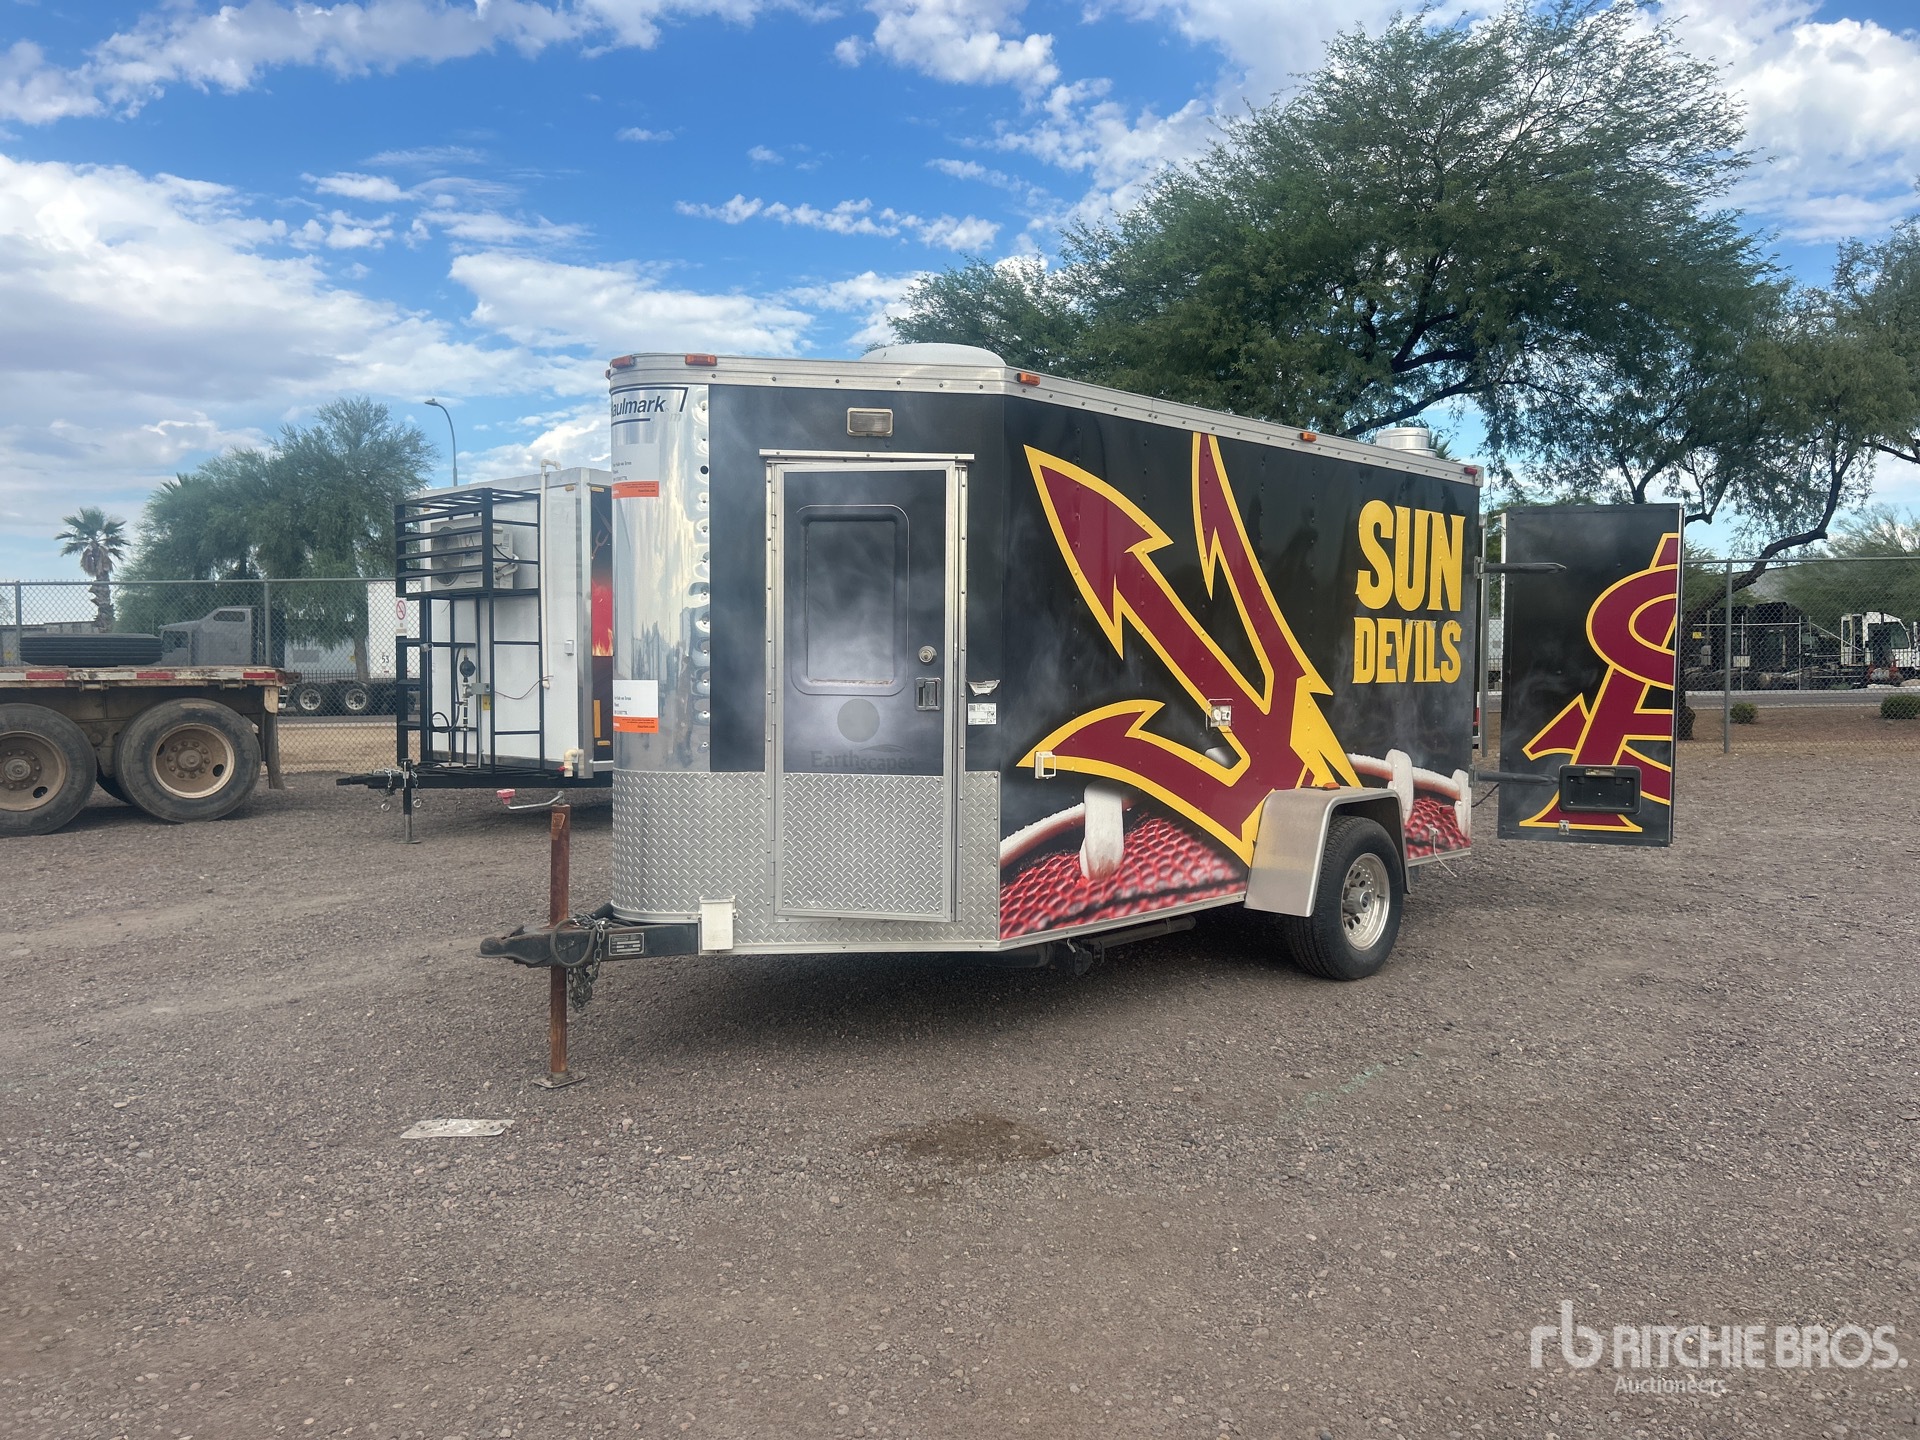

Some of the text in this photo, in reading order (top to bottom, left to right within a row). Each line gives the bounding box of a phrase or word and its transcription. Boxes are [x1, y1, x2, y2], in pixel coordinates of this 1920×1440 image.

[610, 396, 666, 417] aulmark
[1355, 500, 1465, 611] SUN
[381, 655, 390, 664] 53
[1352, 617, 1462, 683] DEVILS
[810, 750, 915, 773] Earthscapes
